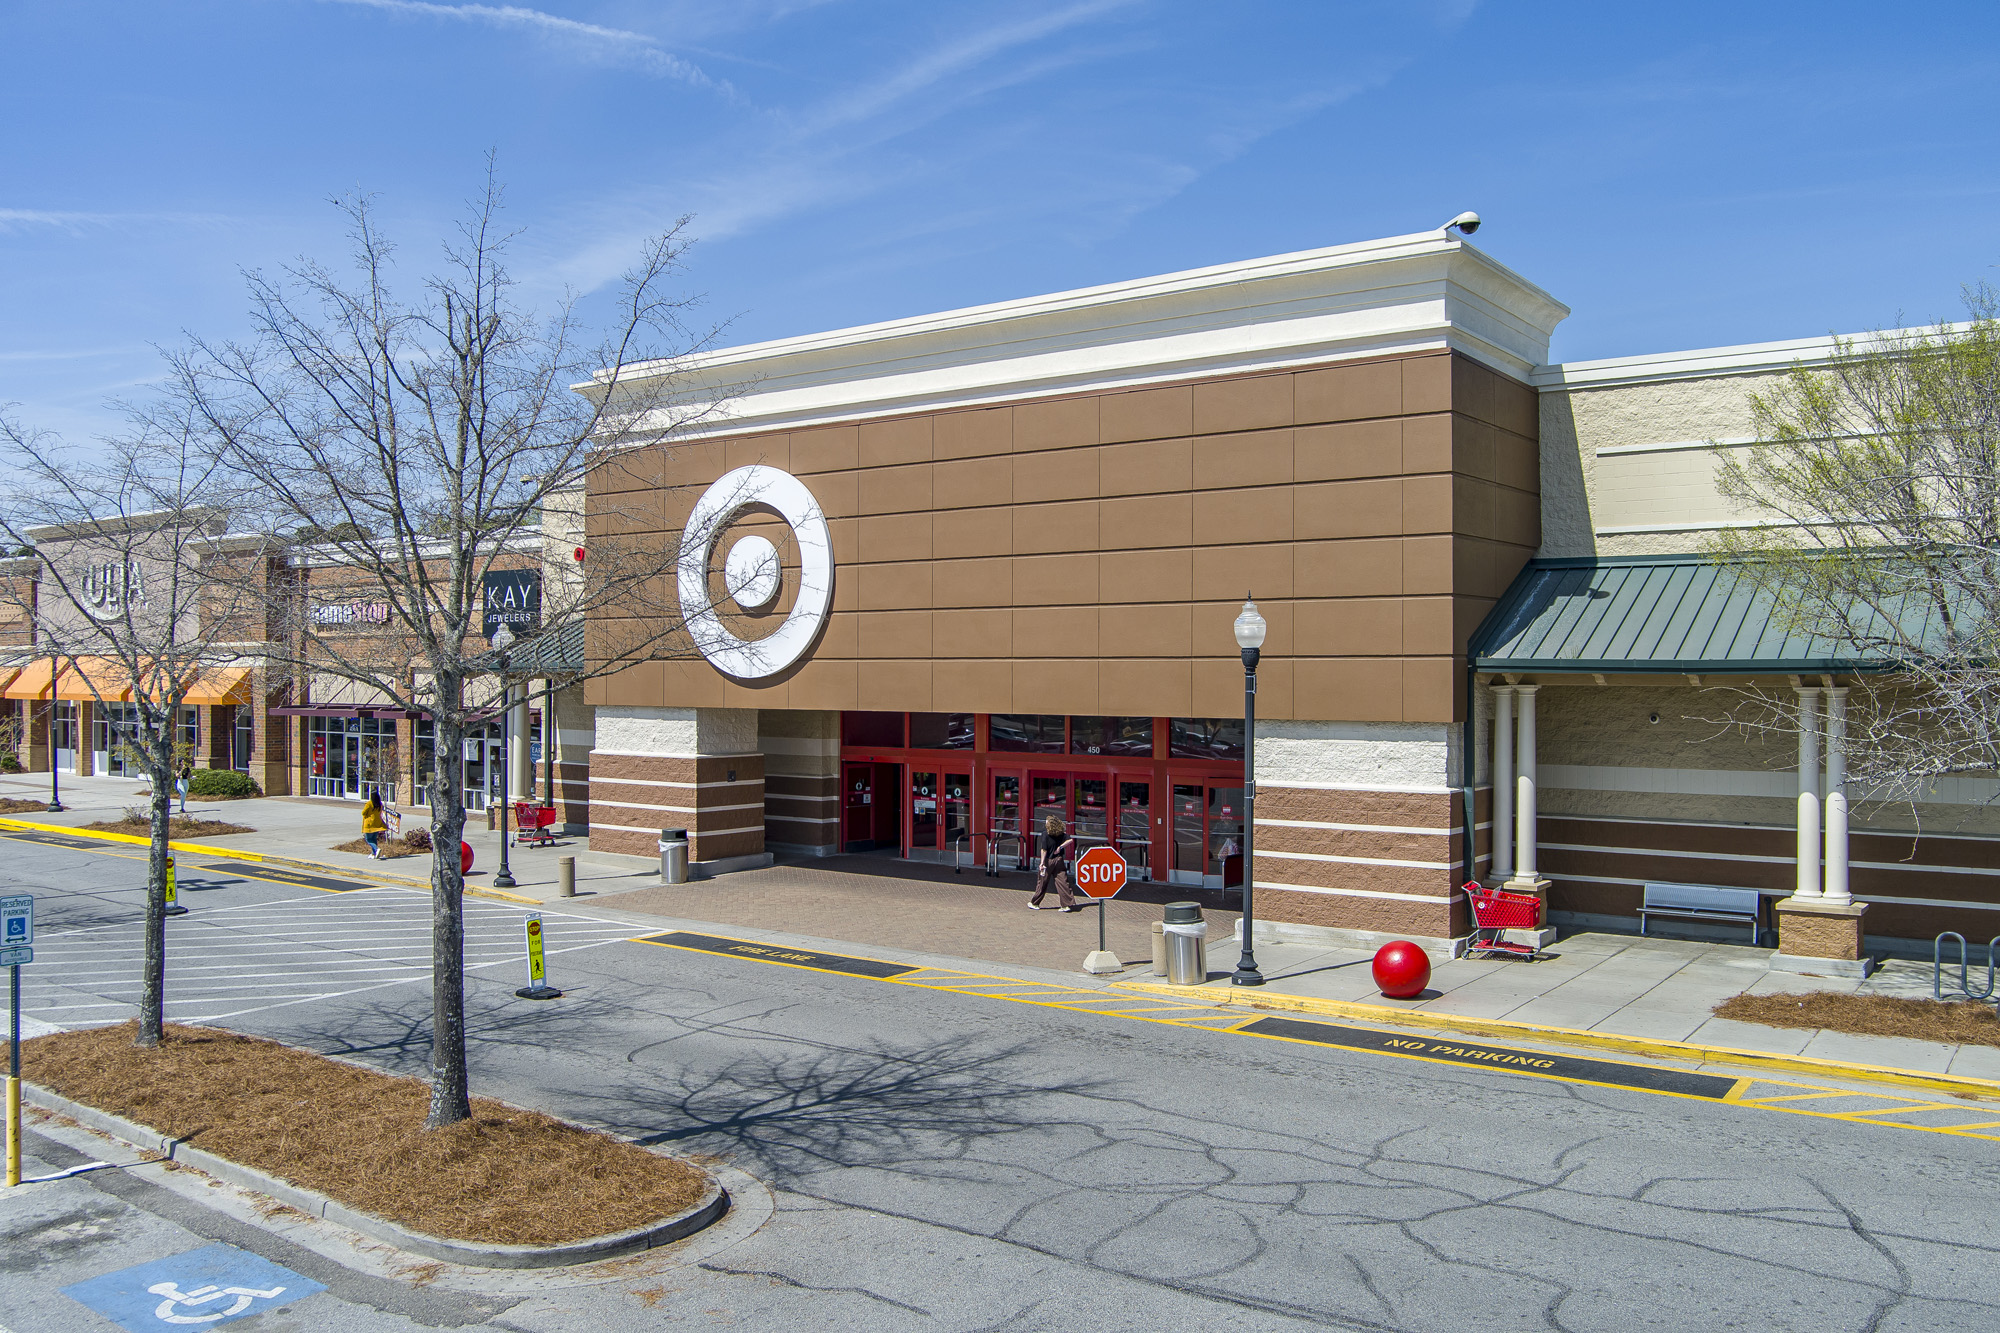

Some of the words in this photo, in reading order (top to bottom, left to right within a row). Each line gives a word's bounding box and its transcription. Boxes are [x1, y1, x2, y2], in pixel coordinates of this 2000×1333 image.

[488, 585, 531, 609] KAY
[488, 613, 531, 623] JEWELERS
[1087, 746, 1101, 754] 450
[1079, 863, 1123, 883] STOP
[1, 899, 31, 908] RESERVED
[3, 908, 29, 917] PARKING
[728, 945, 772, 955] FIRE
[765, 951, 817, 962] LANE
[1384, 1039, 1426, 1050] NO
[1429, 1045, 1556, 1069] PARKING
